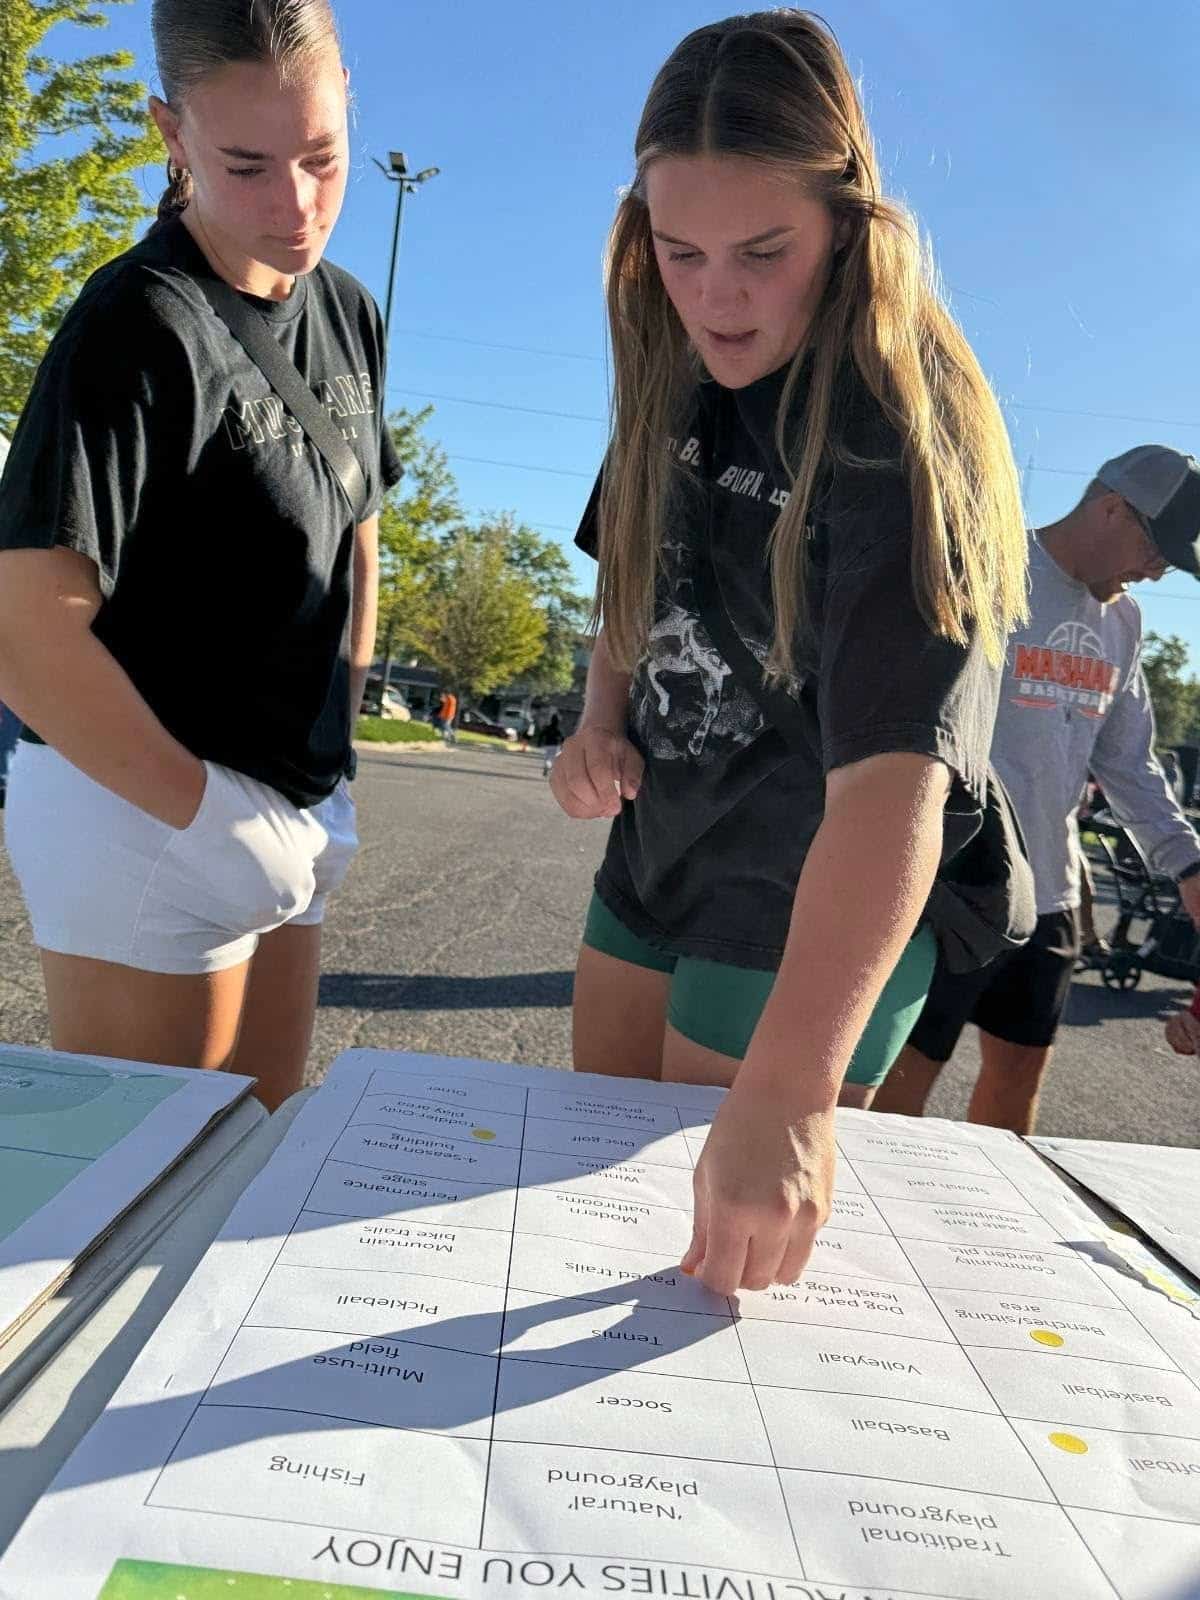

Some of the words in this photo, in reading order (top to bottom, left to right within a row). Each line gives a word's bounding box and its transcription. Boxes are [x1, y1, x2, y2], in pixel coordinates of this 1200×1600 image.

[398, 1101, 430, 1111] area
[435, 1106, 464, 1117] play
[362, 1138, 399, 1154] park
[392, 1133, 454, 1151] building
[572, 1135, 601, 1144] golf
[605, 1139, 635, 1147] Disc
[403, 1146, 478, 1164] 4-season
[577, 1161, 647, 1174] activities
[382, 1174, 427, 1187] stage
[588, 1171, 639, 1183] Winter
[343, 1179, 458, 1201] Performance
[556, 1195, 650, 1216] bathrooms
[570, 1207, 638, 1224] Modern
[363, 1225, 409, 1236] trails
[417, 1232, 456, 1241] bike
[359, 1238, 453, 1253] Mountain
[986, 1250, 1044, 1263] garden
[565, 1262, 611, 1276] trails
[954, 1257, 1056, 1275] Community
[619, 1271, 676, 1286] Paved
[805, 1282, 842, 1294] dog
[848, 1289, 898, 1303] leash
[336, 1295, 438, 1315] Pickleball
[817, 1297, 859, 1308] park
[866, 1301, 904, 1315] Dog
[999, 1301, 1041, 1312] area
[954, 1307, 1105, 1336] Benches/sitting
[591, 1328, 663, 1346] Tennis
[349, 1341, 401, 1359] field
[313, 1355, 424, 1383] Multi-use
[818, 1352, 922, 1376] Volleyball
[1061, 1383, 1173, 1407] Basketball
[595, 1395, 673, 1413] Soccer
[850, 1418, 951, 1441] Baseball
[267, 1455, 366, 1487] Fishing
[1128, 1458, 1200, 1475] oftball
[547, 1469, 698, 1497] playground
[848, 1500, 998, 1530] playground
[861, 1526, 1011, 1557] Traditional
[312, 1535, 463, 1580] ENJOY
[481, 1556, 586, 1589] YOU
